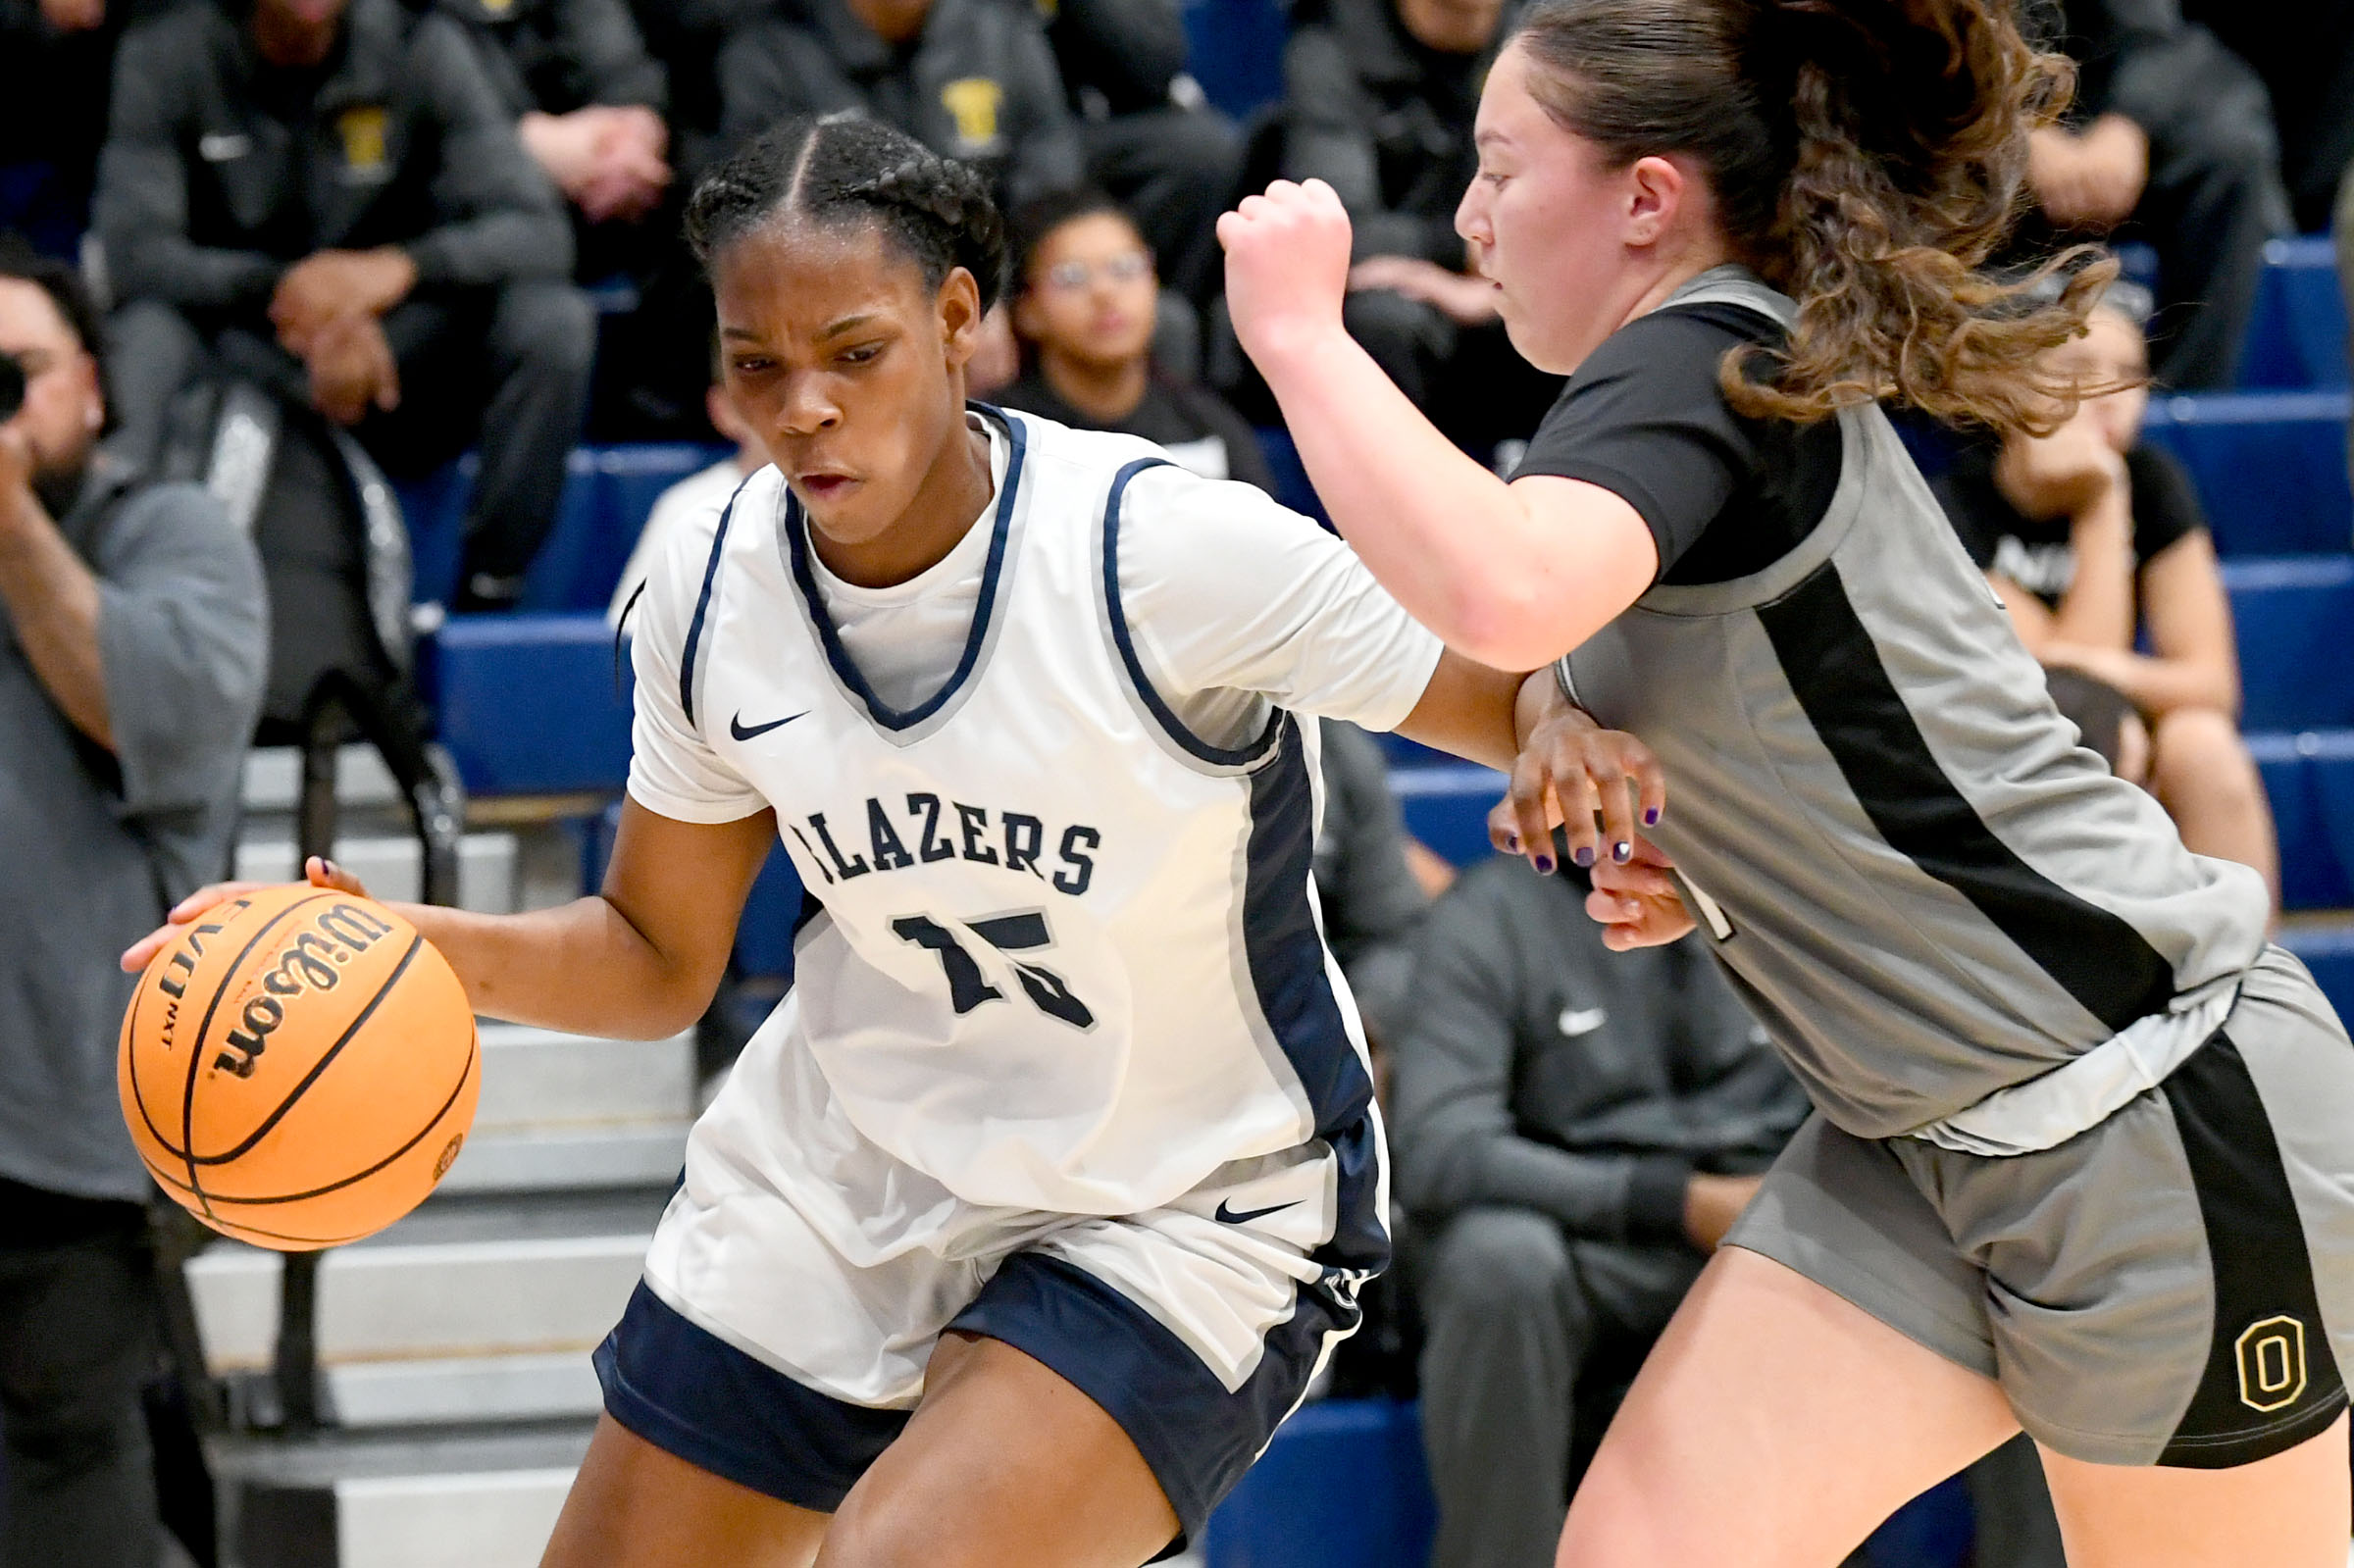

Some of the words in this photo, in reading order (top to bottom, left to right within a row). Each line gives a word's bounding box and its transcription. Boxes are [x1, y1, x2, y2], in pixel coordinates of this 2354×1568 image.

[790, 792, 1101, 896] LAZERS
[161, 1001, 179, 1052] NXT
[213, 903, 394, 1080] Wilson
